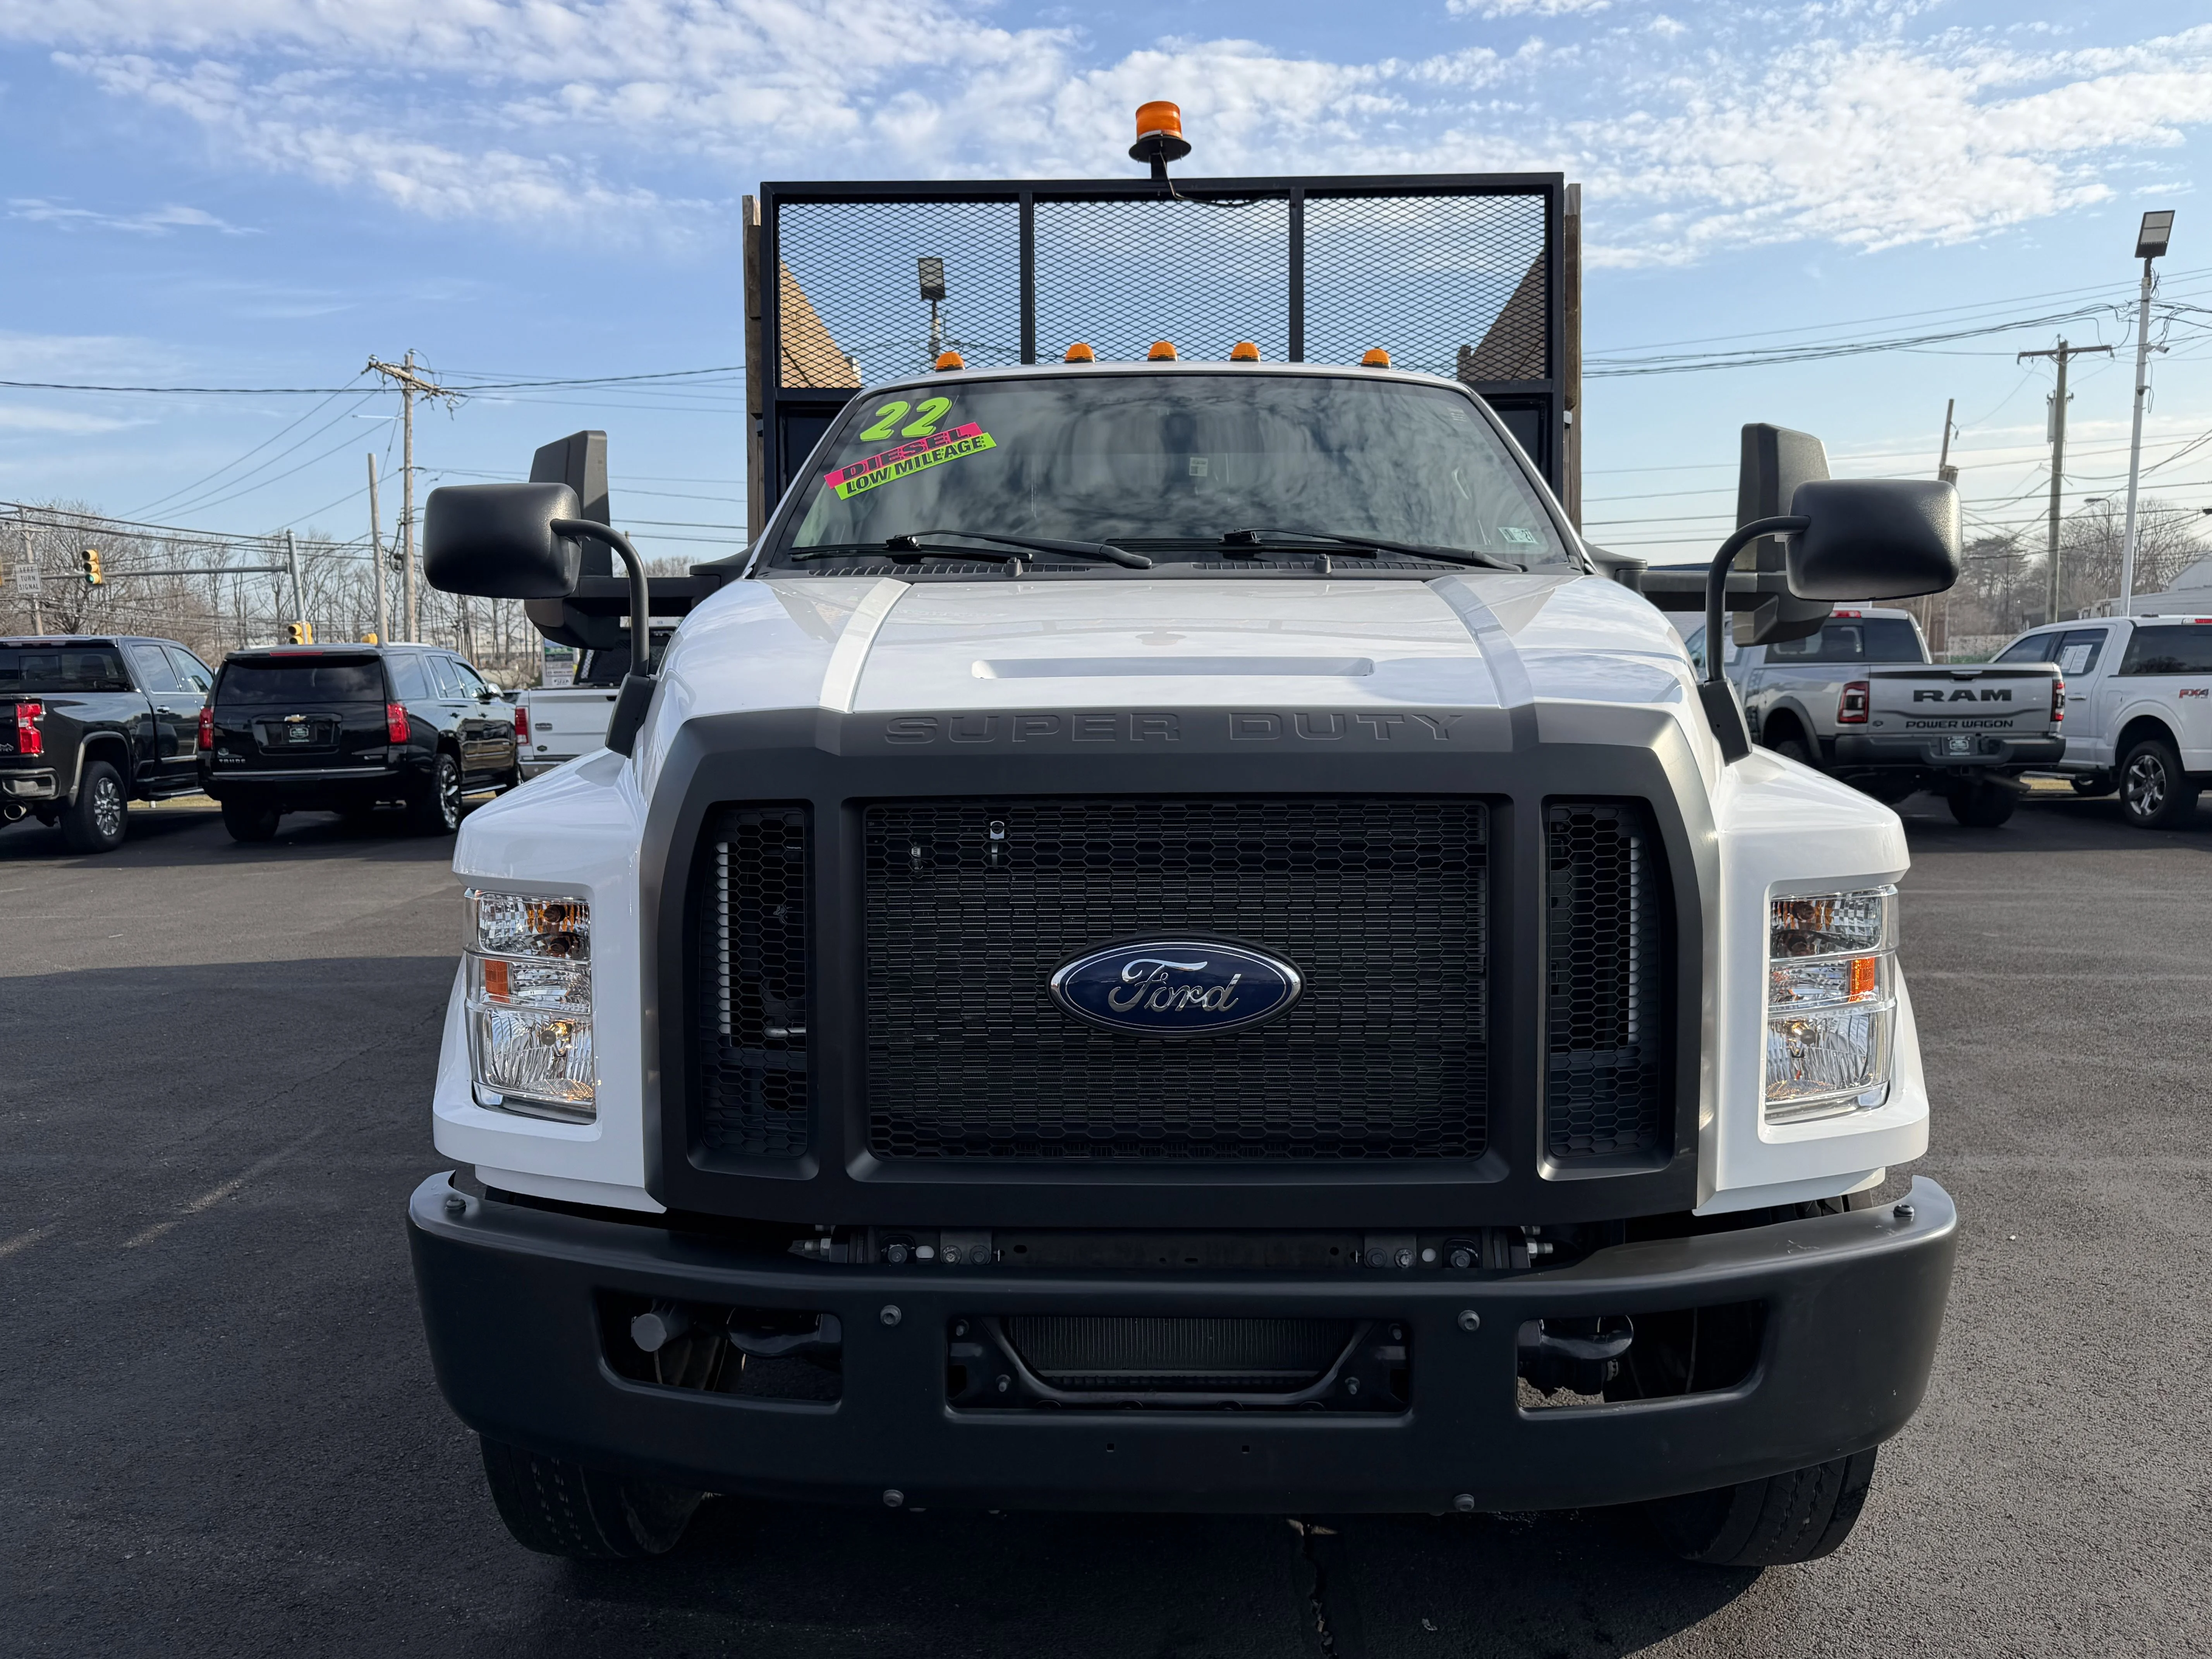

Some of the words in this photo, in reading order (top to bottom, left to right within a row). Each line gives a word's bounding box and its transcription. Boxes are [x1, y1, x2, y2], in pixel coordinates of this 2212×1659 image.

[860, 397, 953, 441] 22
[842, 429, 972, 481] DIESEL
[846, 467, 891, 495] LOW
[895, 436, 986, 475] MILEAGE
[1913, 689, 2012, 702] RAM
[2179, 688, 2209, 699] FX4
[885, 713, 1180, 744] SUPER
[1229, 713, 1463, 740] DUTY
[1906, 720, 1958, 729] POWER
[1962, 720, 2014, 728] WAGON
[1108, 958, 1241, 1012] Ford
